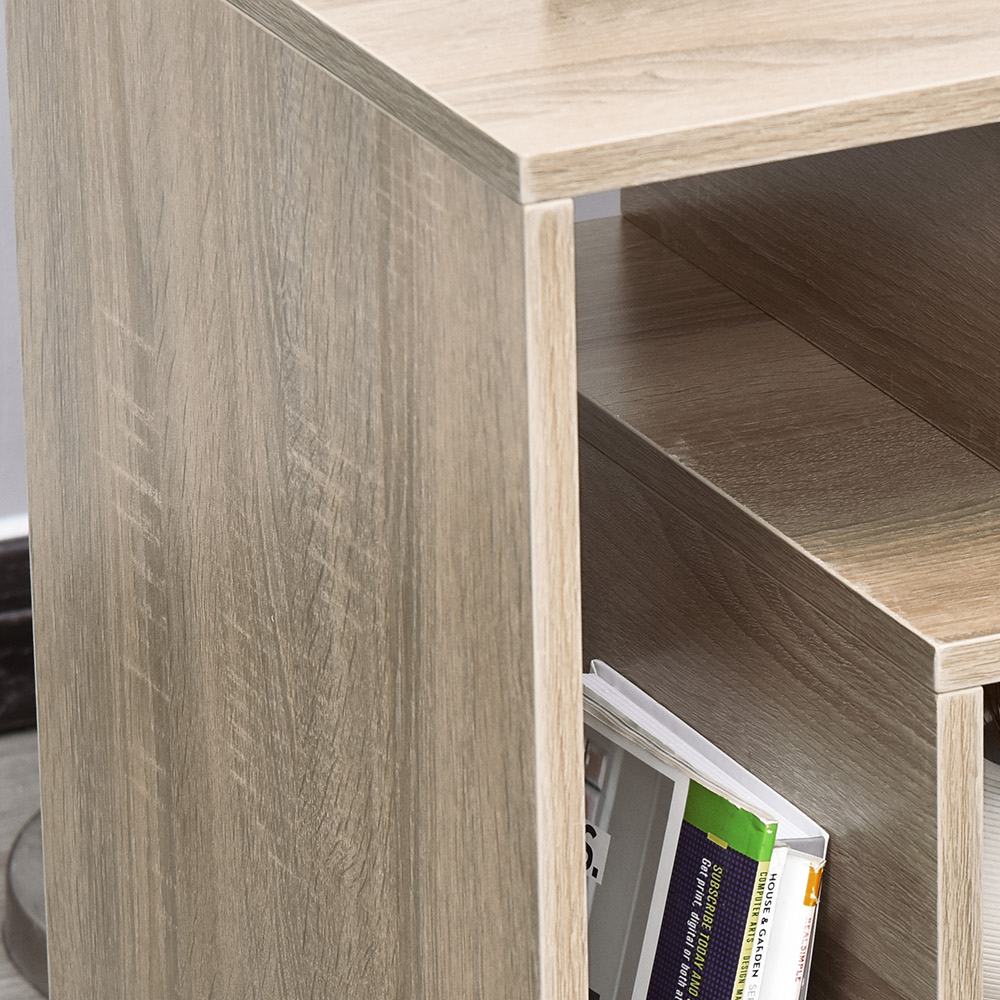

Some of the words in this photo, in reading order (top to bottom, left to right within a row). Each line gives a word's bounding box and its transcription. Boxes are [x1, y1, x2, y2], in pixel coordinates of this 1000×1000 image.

[700, 858, 712, 877] Get
[701, 863, 723, 931] SUBSCRIBE
[752, 871, 767, 918] COMPUTER
[763, 873, 777, 913] HOUSE
[684, 910, 701, 947] digital
[747, 922, 756, 943] ARTS
[761, 918, 769, 926] &
[683, 948, 693, 962] or
[693, 931, 709, 970] TODAY
[751, 929, 767, 978] GARDEN
[678, 961, 690, 987] both
[687, 969, 701, 997] AND
[738, 956, 750, 984] DESIGN
